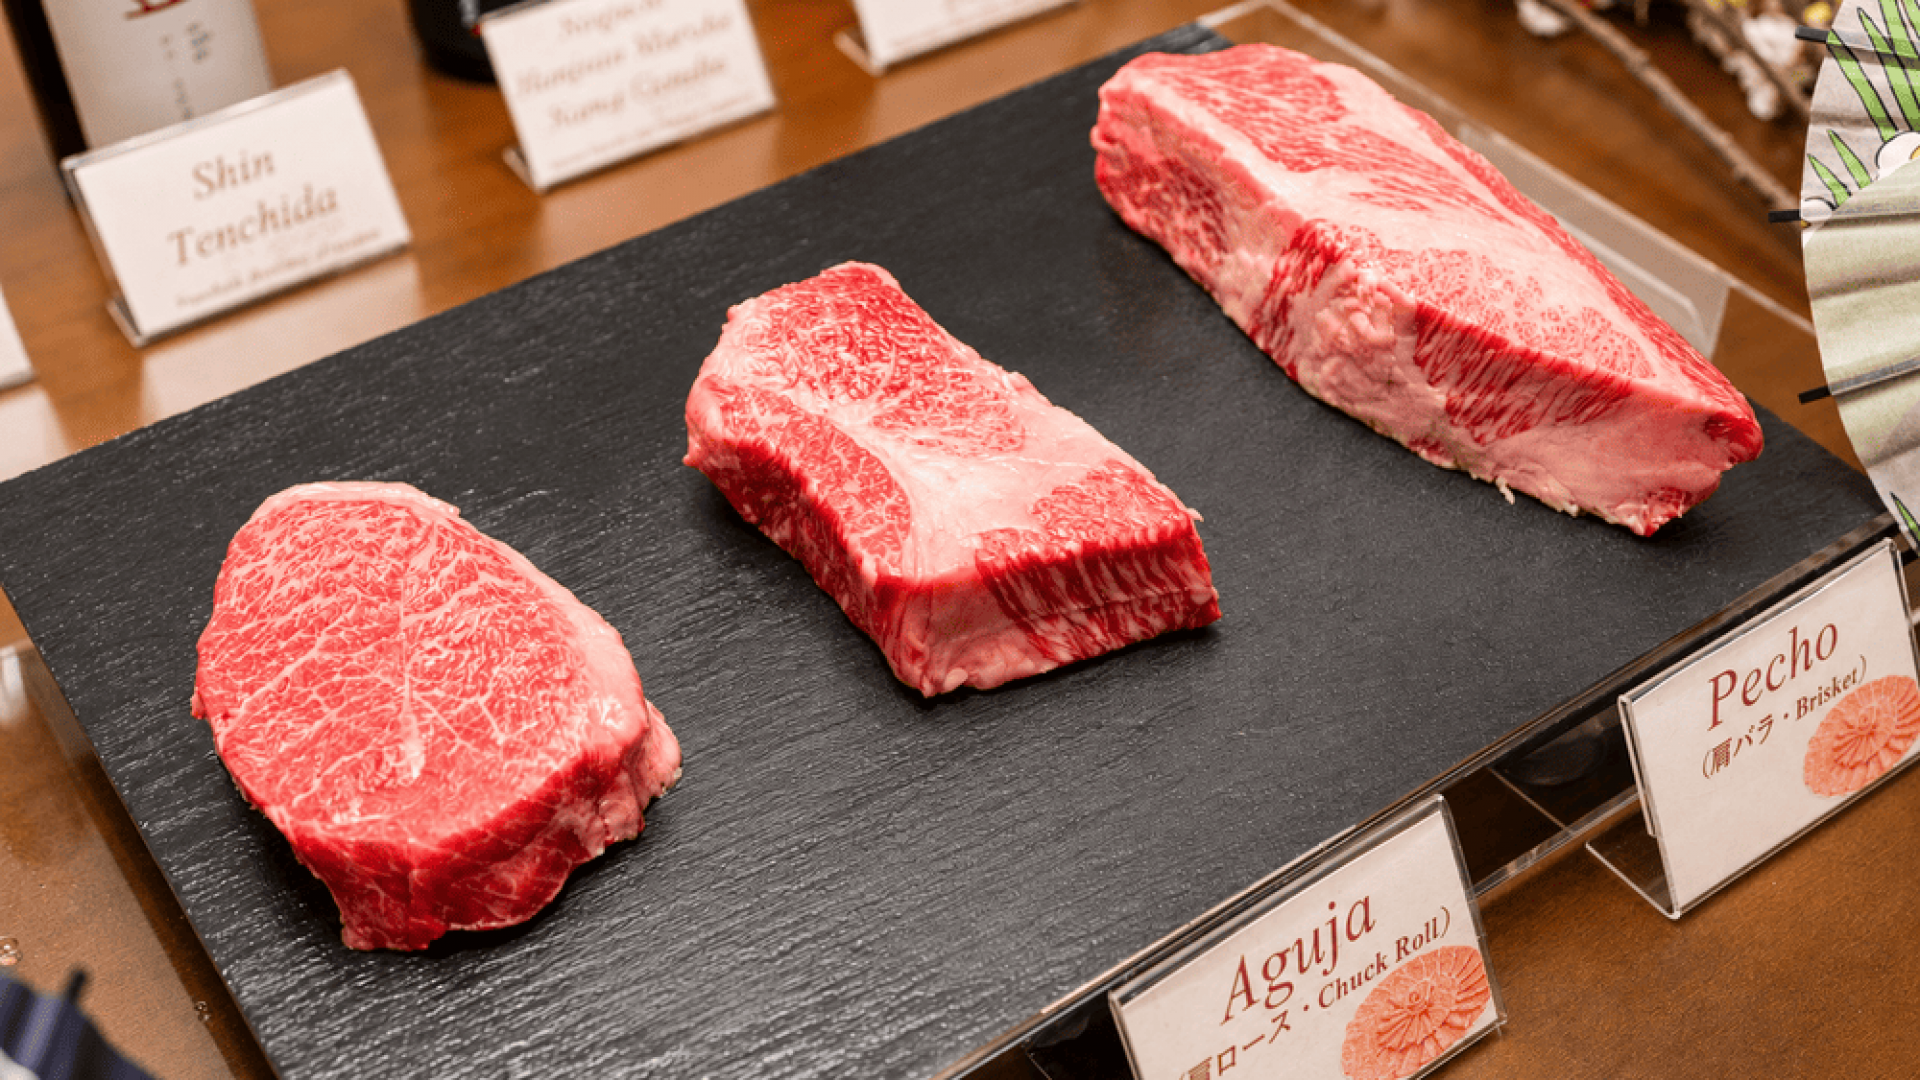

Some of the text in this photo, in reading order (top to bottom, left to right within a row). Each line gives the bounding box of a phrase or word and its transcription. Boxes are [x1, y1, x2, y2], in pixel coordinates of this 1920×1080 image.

[191, 149, 275, 201] Shin
[1707, 623, 1838, 731] Pecho
[1219, 895, 1377, 1025] Aguja
[1318, 952, 1388, 1010] Chuck
[1395, 905, 1451, 964] Roll)
